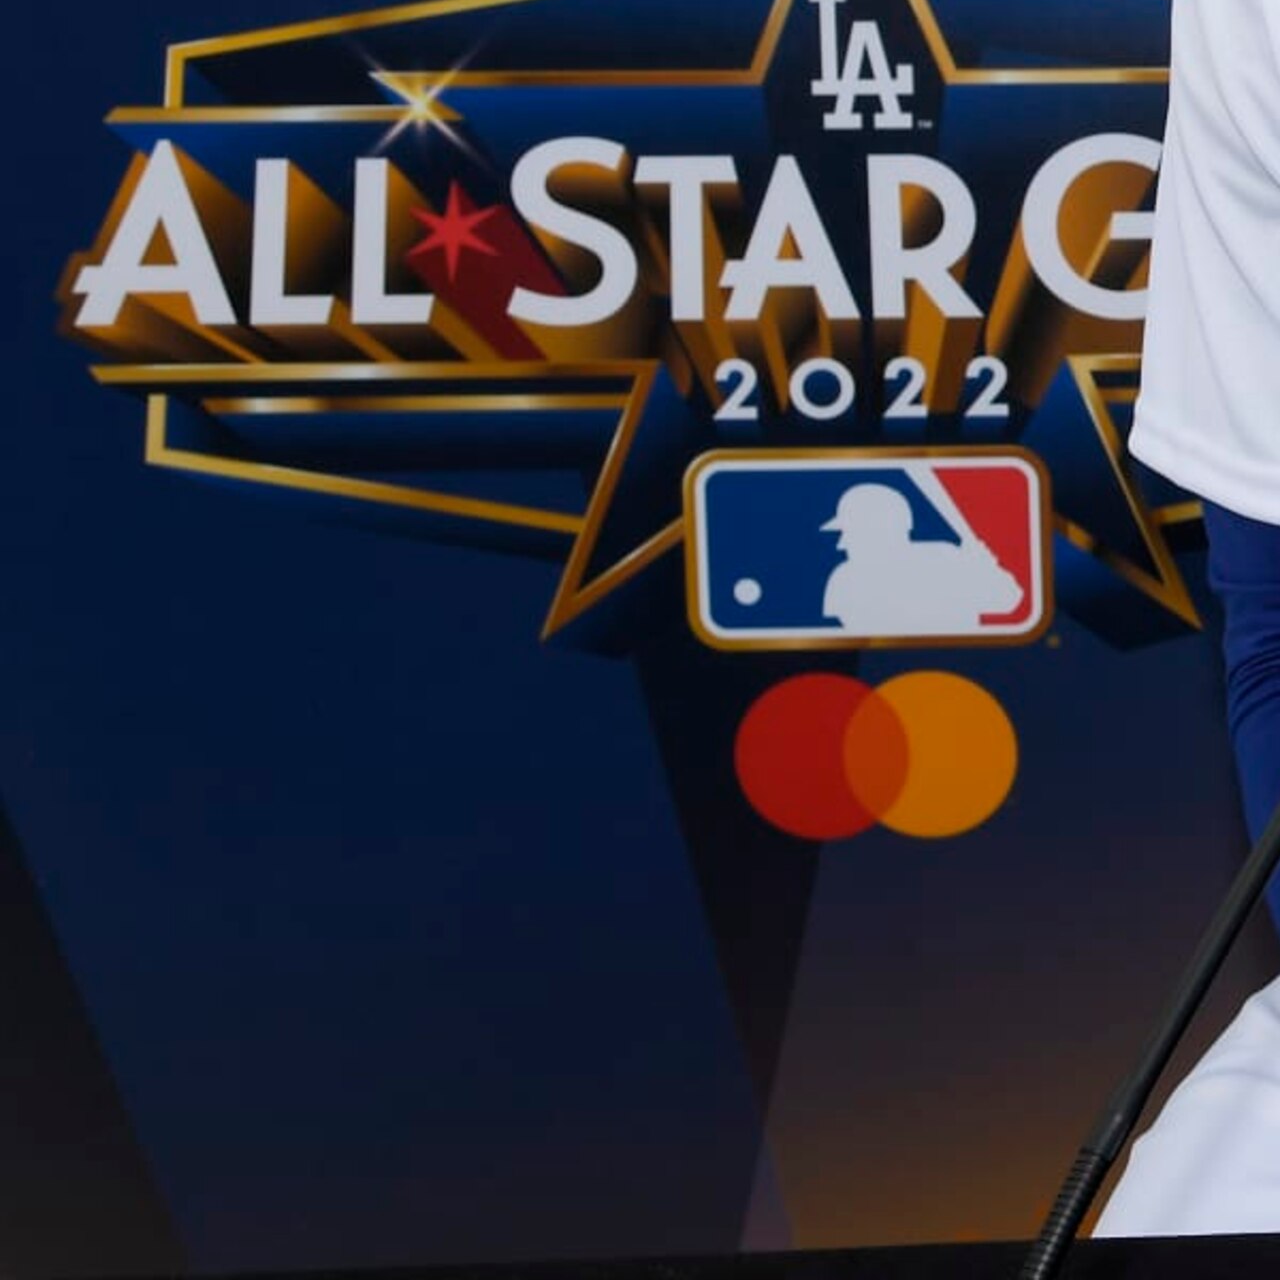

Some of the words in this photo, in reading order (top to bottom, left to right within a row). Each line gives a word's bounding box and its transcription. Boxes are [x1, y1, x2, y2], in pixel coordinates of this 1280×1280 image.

[72, 138, 437, 328] ALL
[506, 135, 984, 328] STAR
[713, 357, 1010, 420] 2022
